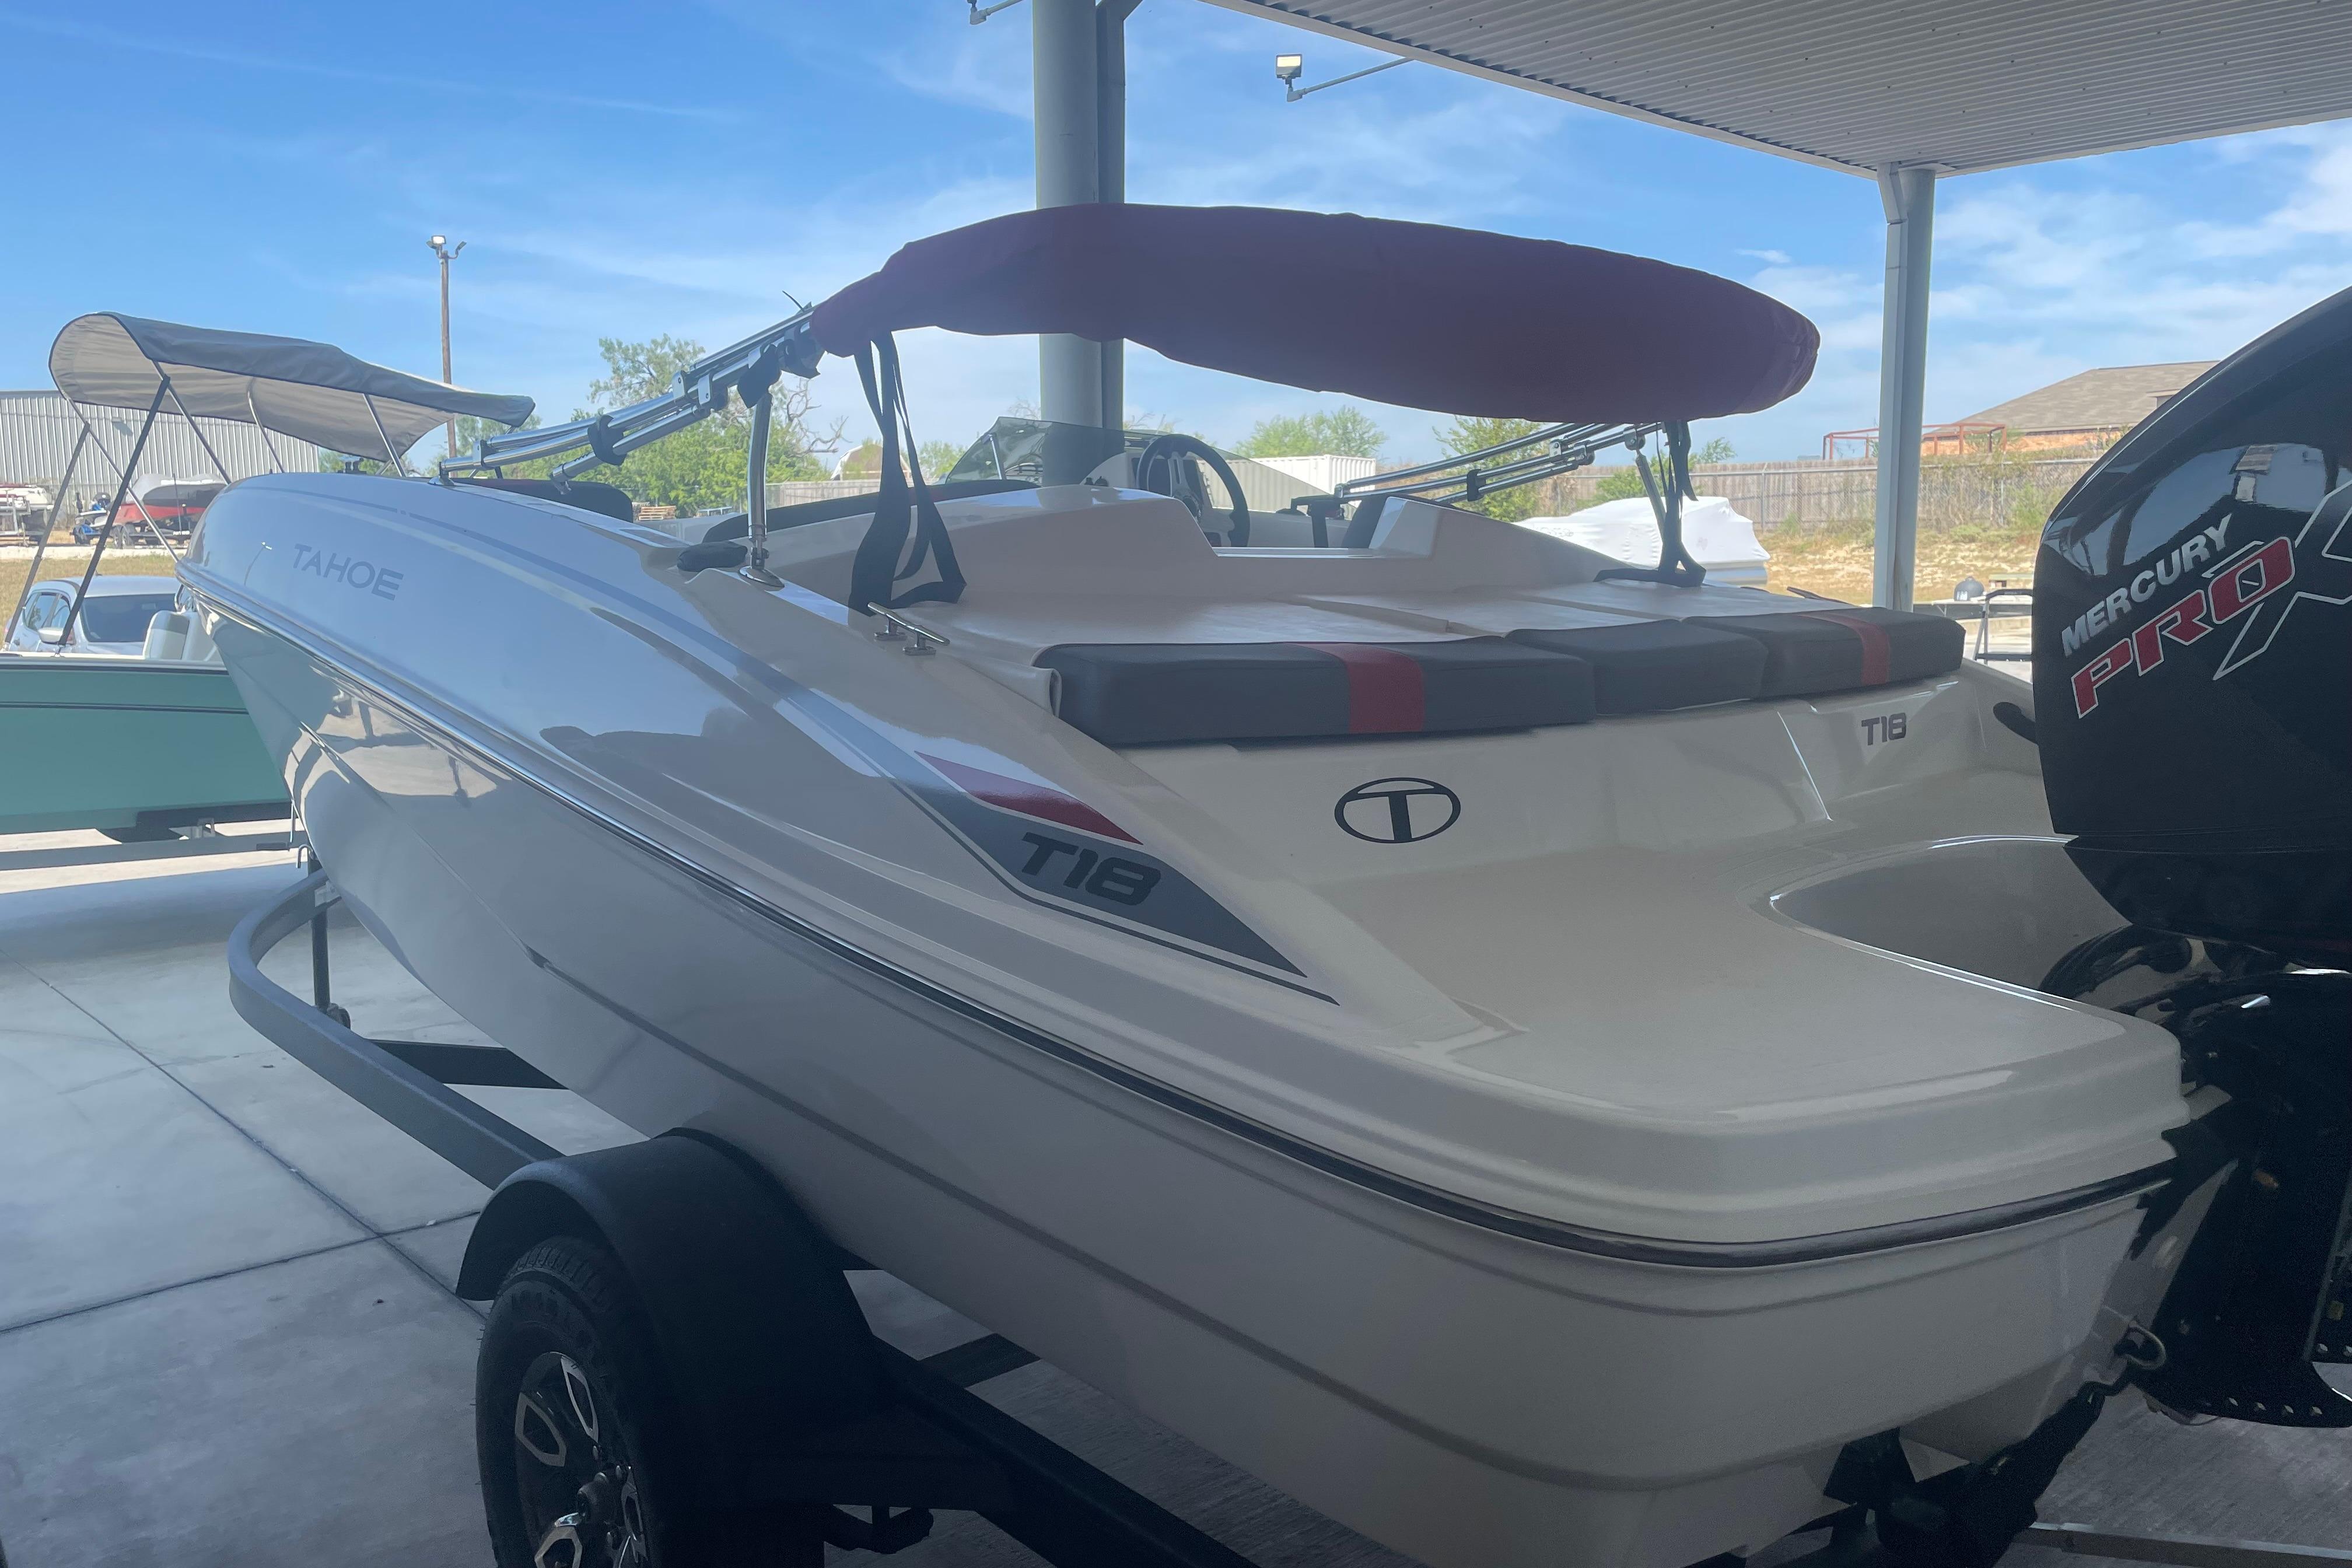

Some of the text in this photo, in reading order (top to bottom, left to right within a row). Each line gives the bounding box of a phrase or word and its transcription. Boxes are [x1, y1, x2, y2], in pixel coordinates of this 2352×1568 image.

[293, 543, 404, 601] TAHOE
[2061, 513, 2232, 657] MERCURY
[2070, 536, 2296, 719] PRO
[1861, 712, 1907, 746] T18
[1021, 832, 1161, 906] T18
